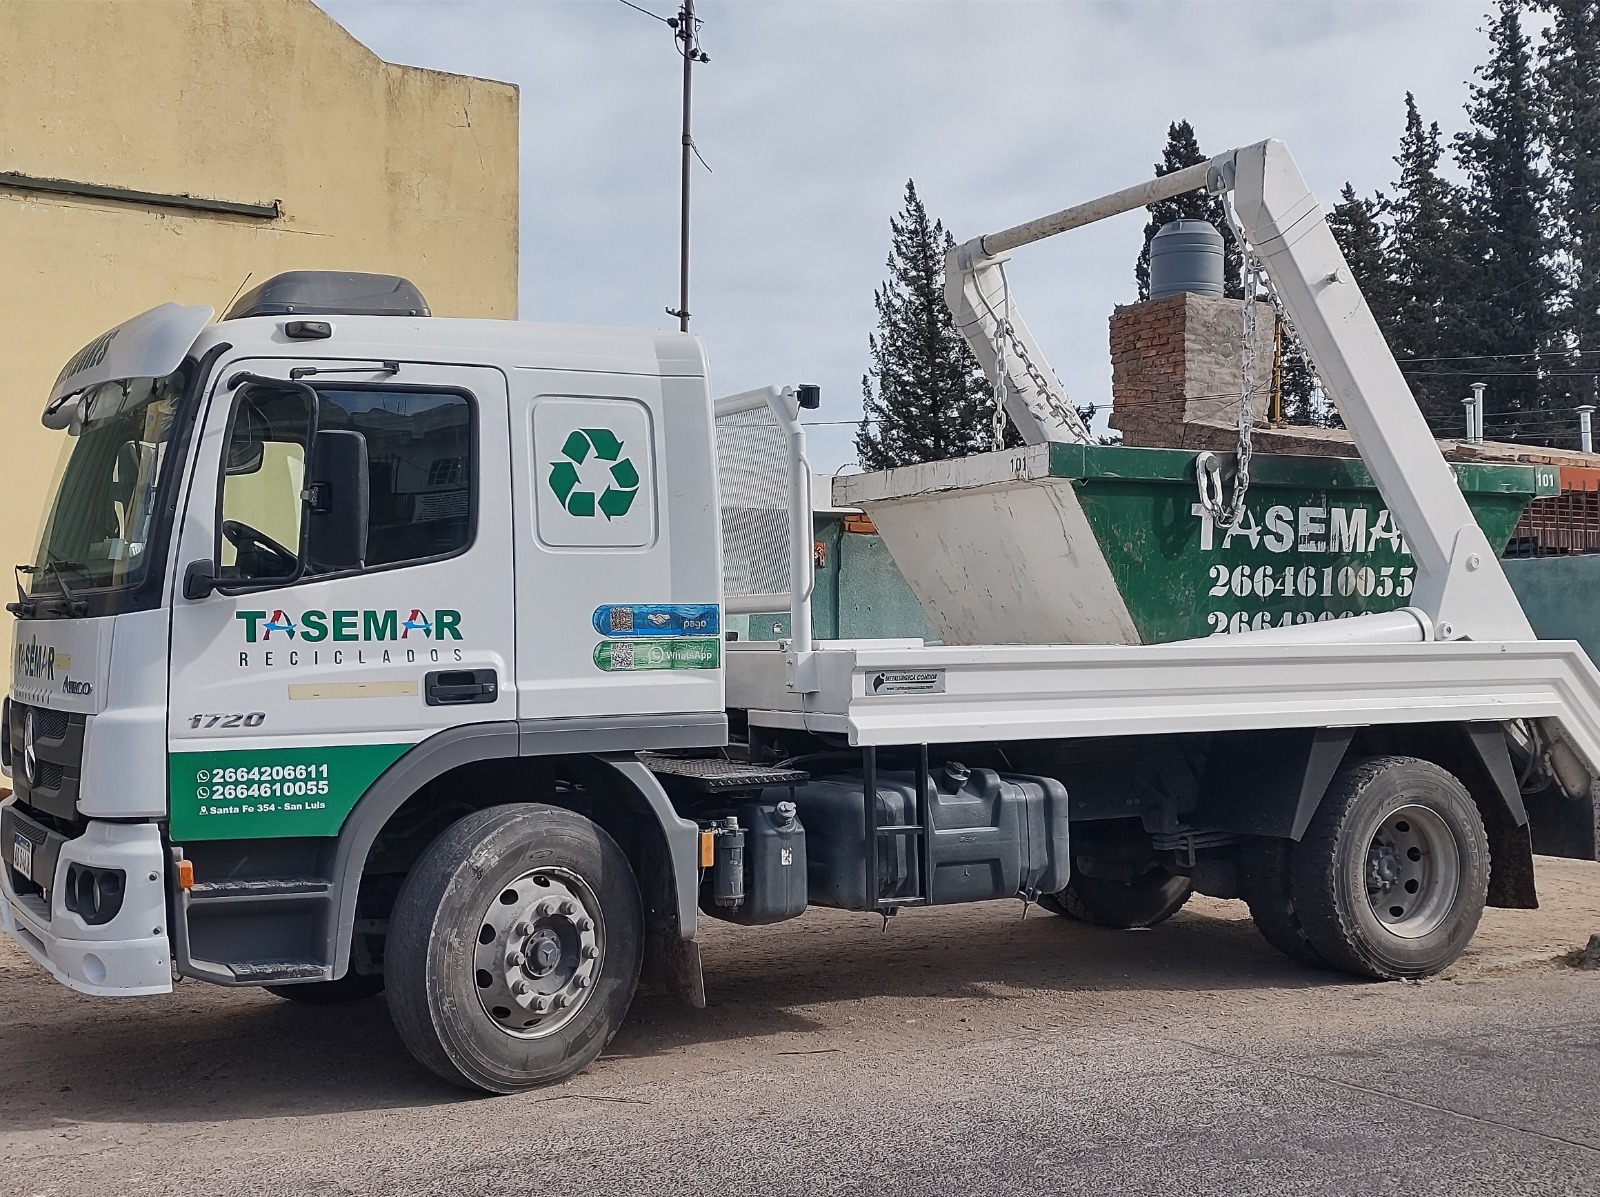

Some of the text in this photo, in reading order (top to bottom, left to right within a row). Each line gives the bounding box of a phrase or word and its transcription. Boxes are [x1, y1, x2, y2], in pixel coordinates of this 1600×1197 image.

[1010, 456, 1026, 473] 101
[1537, 473, 1554, 487] 101
[1192, 502, 1411, 554] TASEMA
[1208, 564, 1414, 597] 2664610055
[236, 609, 463, 642] TASEMAR
[239, 648, 462, 667] RECICLADOS
[665, 647, 712, 662] WhatsApp
[187, 712, 266, 729] 1720
[212, 764, 328, 782] 2664206611
[212, 780, 328, 799] 2664610055
[210, 806, 240, 815] Santa
[257, 804, 275, 812] 354
[284, 802, 303, 811] San
[305, 801, 326, 810] Luis
